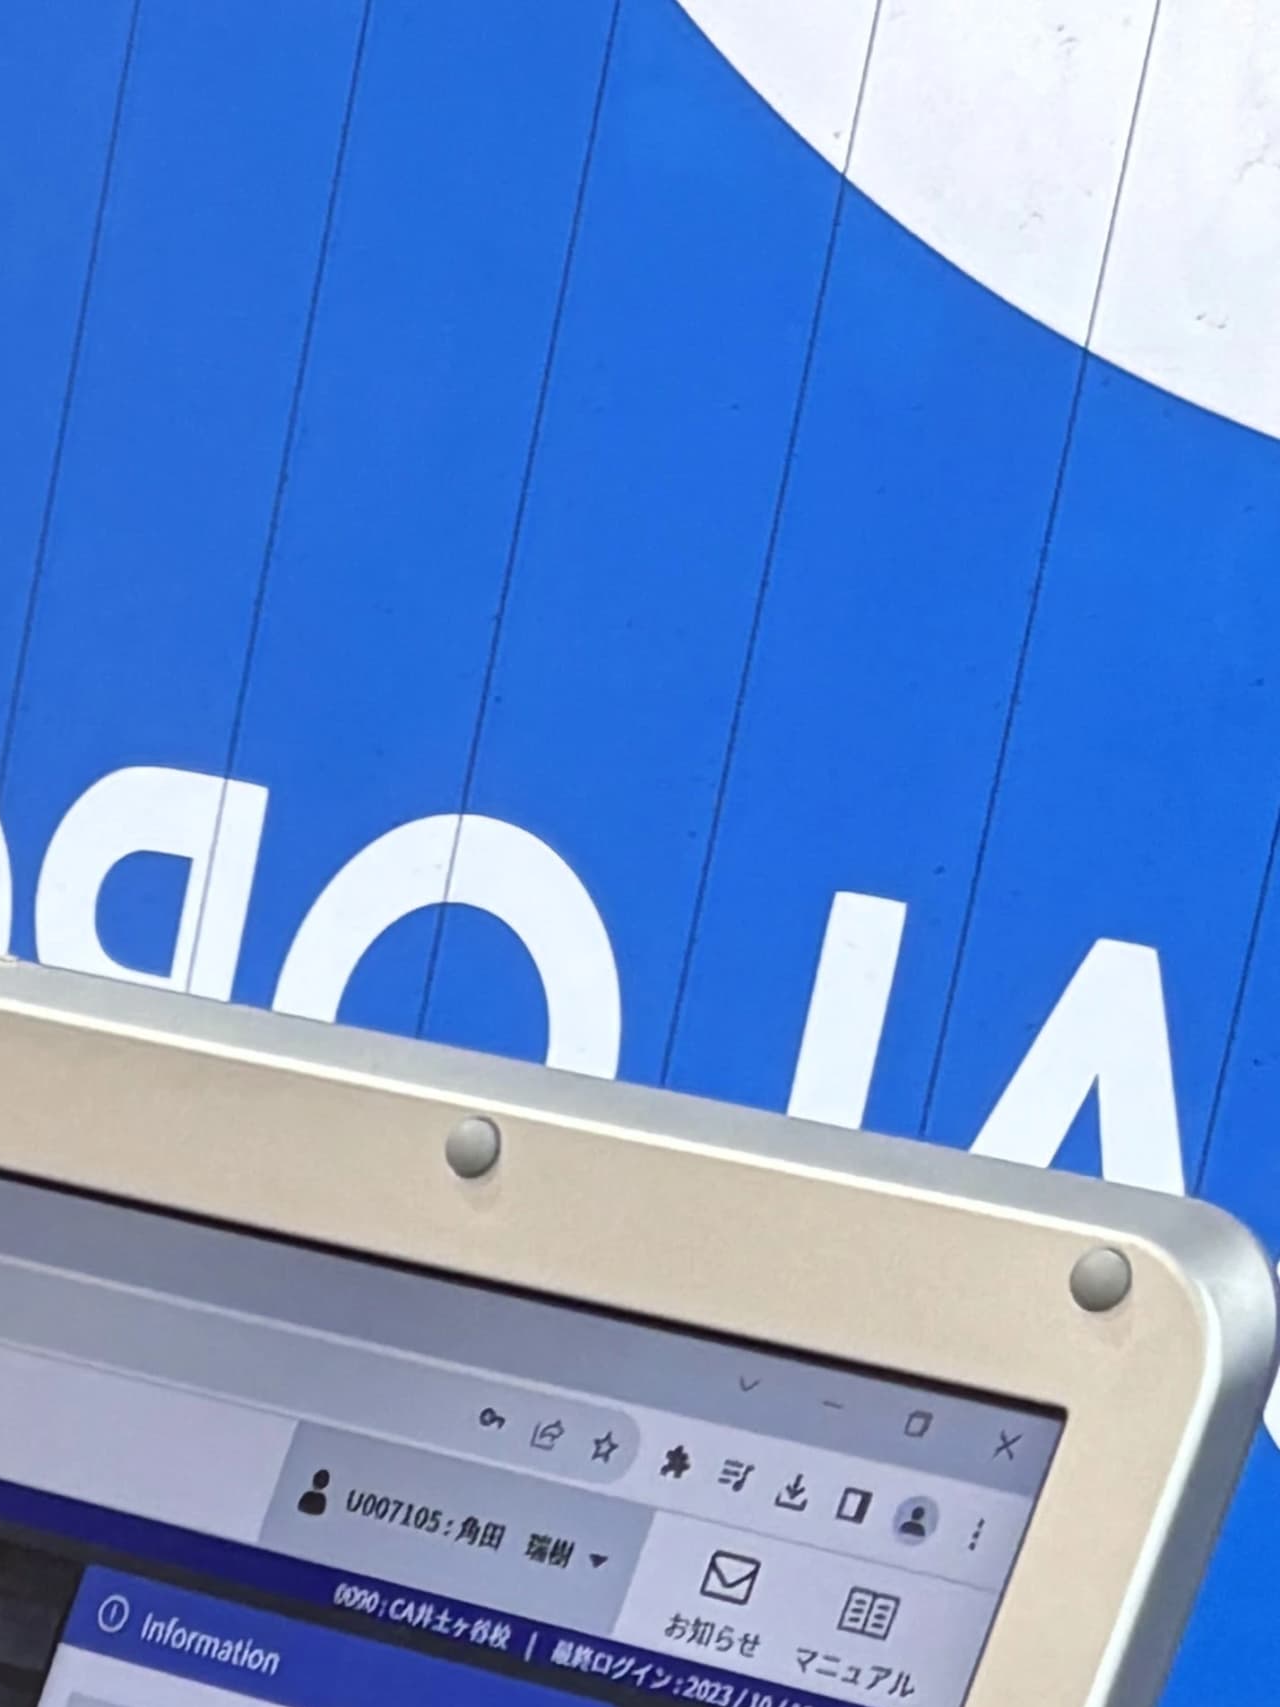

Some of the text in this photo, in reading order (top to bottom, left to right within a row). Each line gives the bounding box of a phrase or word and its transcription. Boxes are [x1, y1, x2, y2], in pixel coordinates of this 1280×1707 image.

[139, 1609, 282, 1679] Information
[664, 1612, 761, 1659] お知らせ
[794, 1646, 916, 1700] マニュアル
